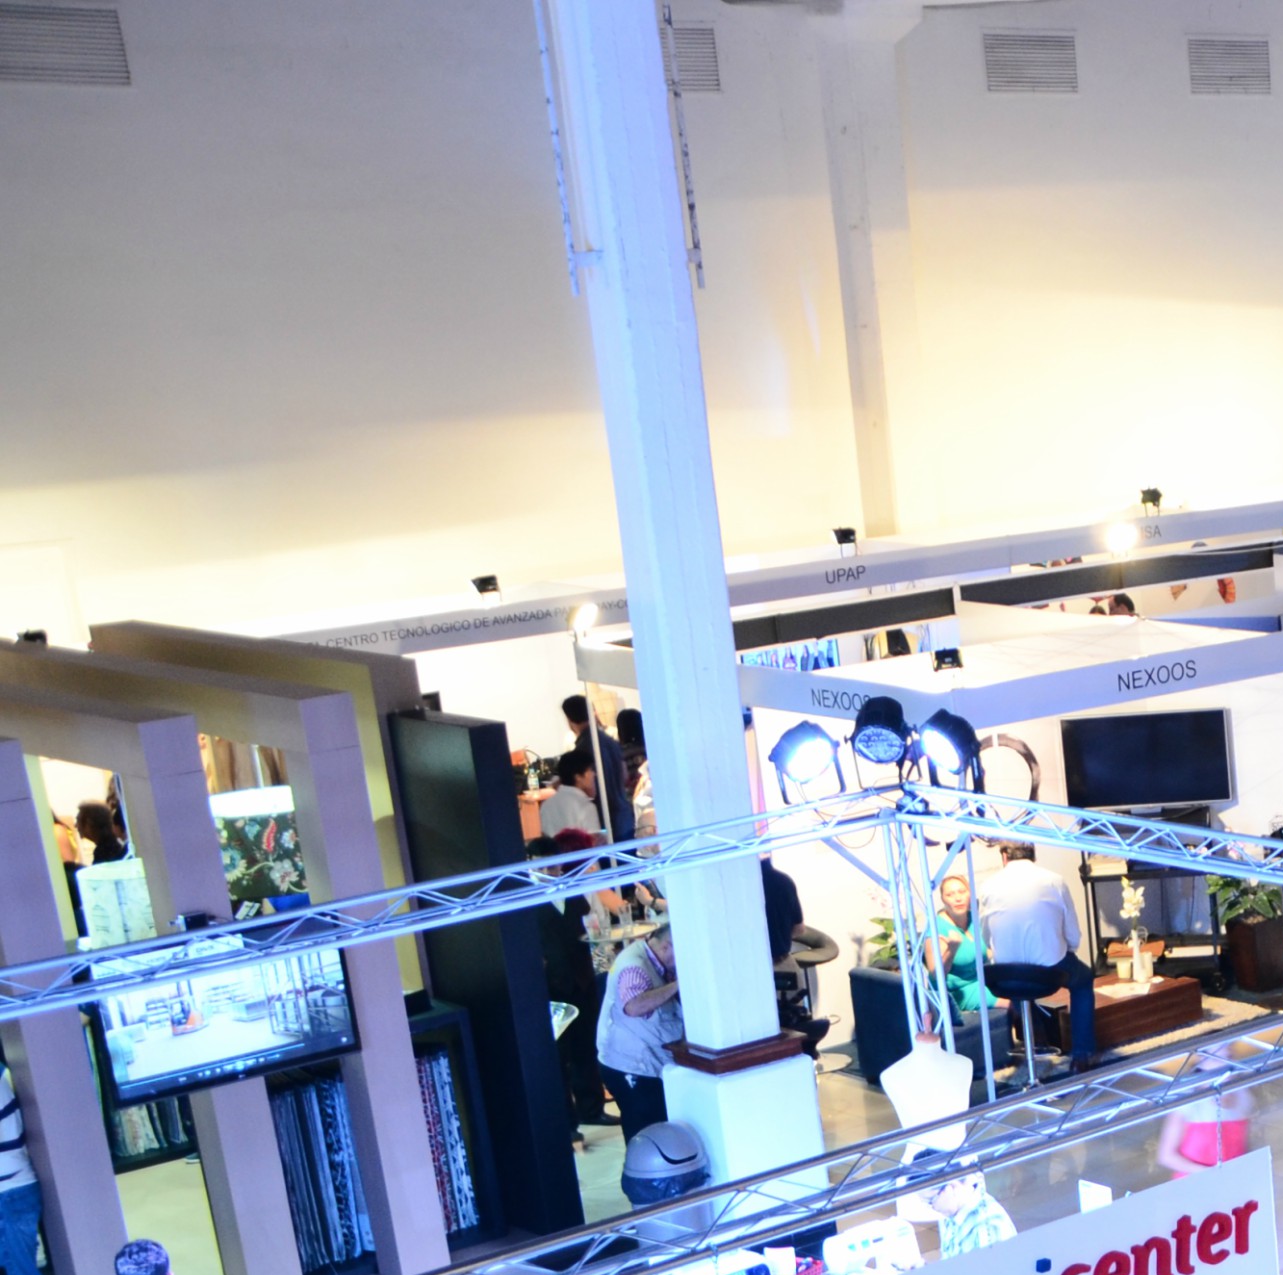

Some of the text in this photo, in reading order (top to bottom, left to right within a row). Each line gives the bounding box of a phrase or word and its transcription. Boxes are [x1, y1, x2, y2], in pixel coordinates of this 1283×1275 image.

[825, 565, 867, 585] UPAP
[382, 618, 471, 642] TECNOLOGICO
[473, 616, 491, 630] DE
[492, 608, 553, 627] AVANZADA
[1117, 659, 1198, 692] NEXOOS
